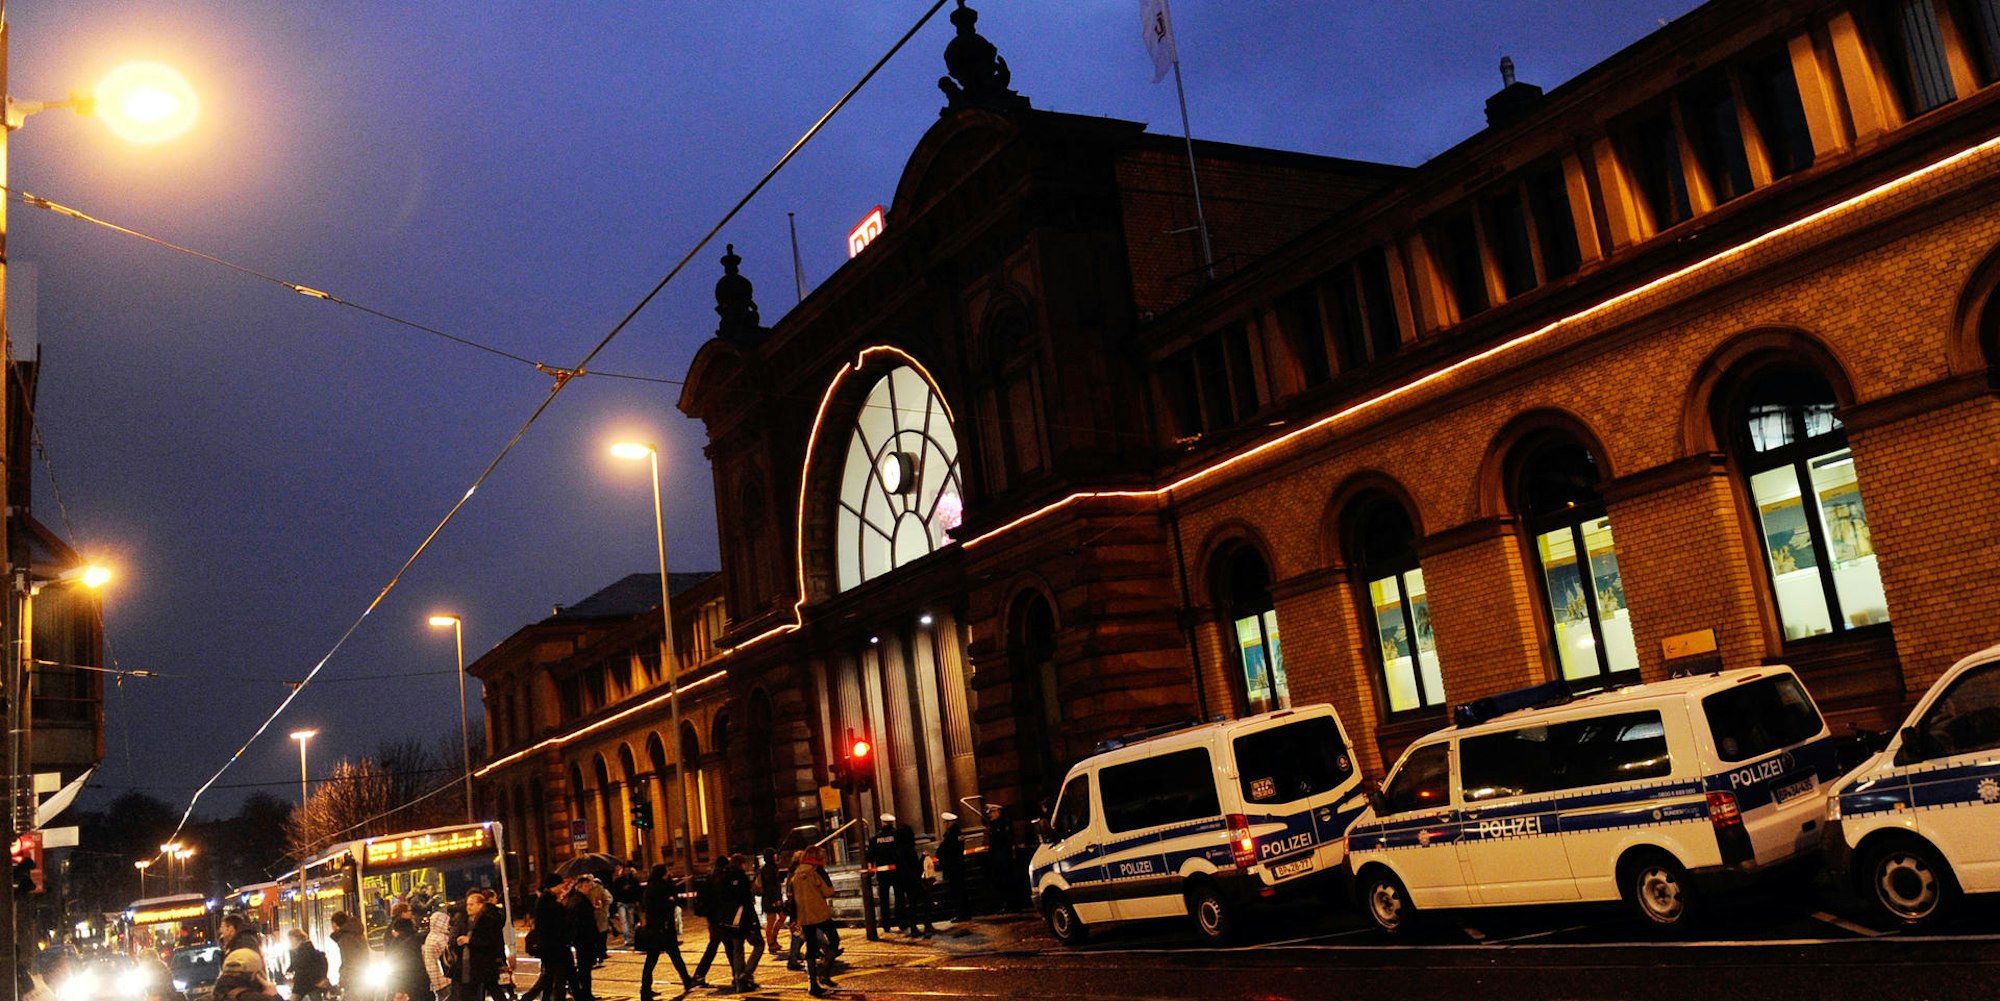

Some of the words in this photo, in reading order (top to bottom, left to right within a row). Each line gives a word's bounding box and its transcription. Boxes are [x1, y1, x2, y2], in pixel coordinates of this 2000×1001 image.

[1729, 758, 1784, 790] POLIZEI
[1479, 816, 1542, 839] POLIZEI
[1260, 831, 1314, 858] POLIZEI
[1119, 860, 1154, 876] POLIZEI
